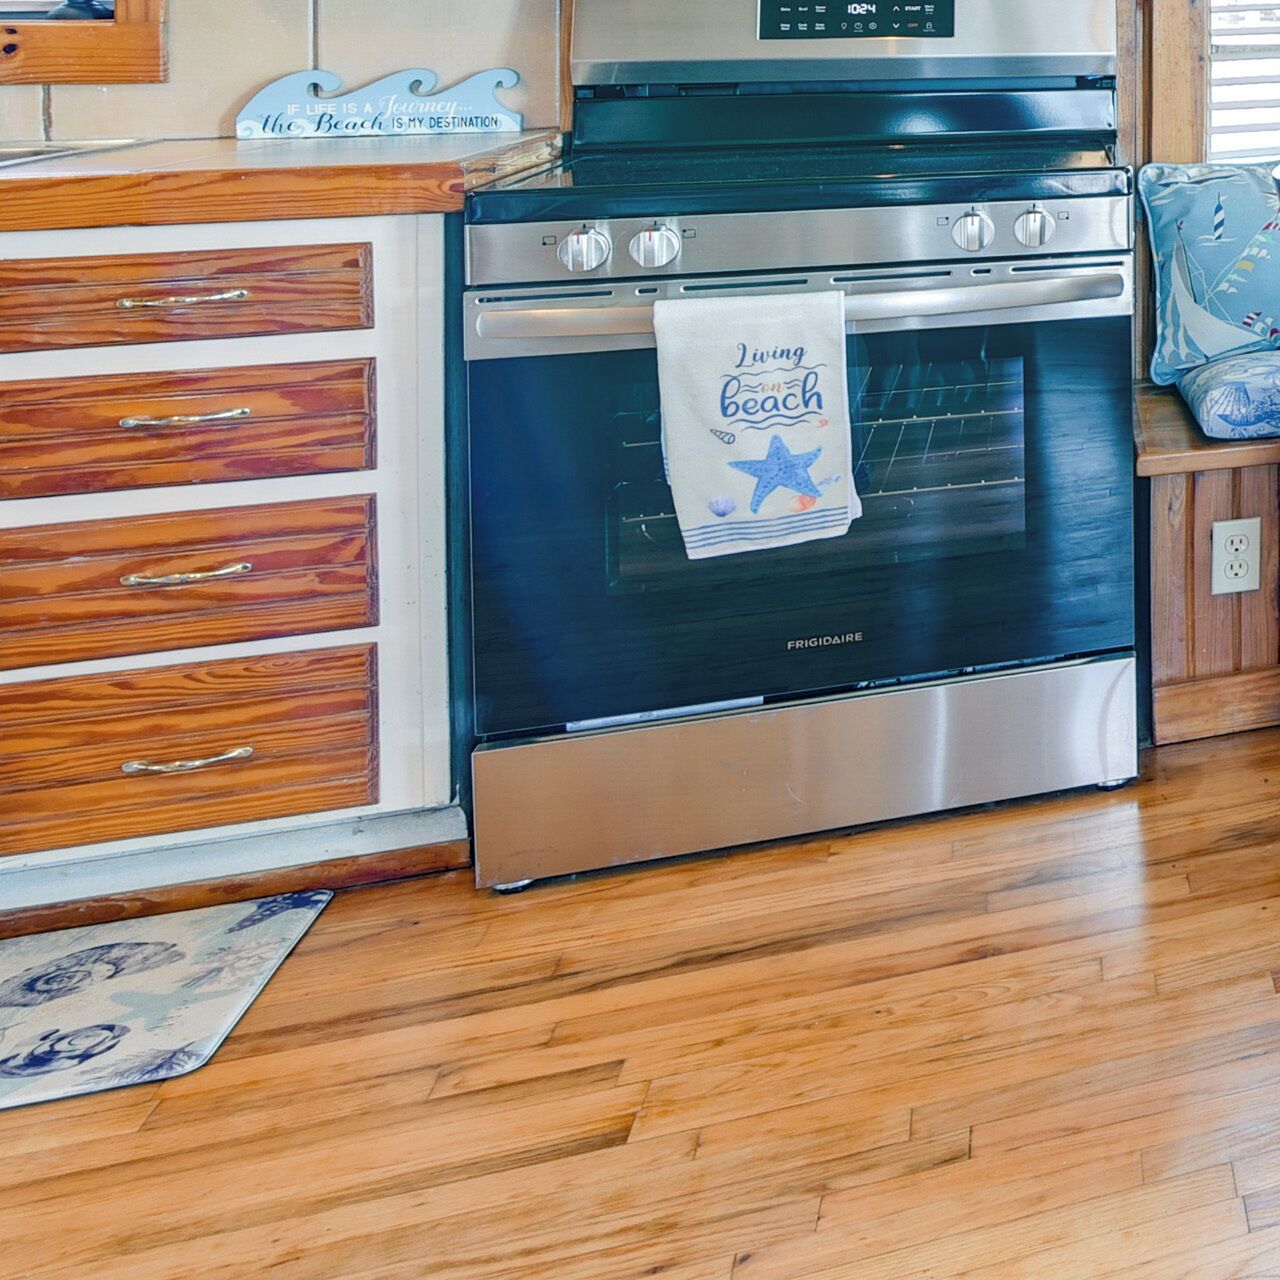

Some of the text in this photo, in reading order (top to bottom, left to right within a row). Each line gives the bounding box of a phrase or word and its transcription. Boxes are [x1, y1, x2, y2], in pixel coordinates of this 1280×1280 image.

[287, 104, 300, 116] IF
[306, 103, 337, 116] LIFE
[343, 102, 358, 114] IS
[363, 102, 373, 114] A
[312, 112, 385, 134] Beach
[392, 117, 403, 128] IS
[408, 117, 424, 128] MY
[429, 115, 498, 128] DESTINATION
[735, 342, 809, 368] Living
[720, 371, 823, 417] beach
[787, 632, 863, 650] FRIGIDAIRE
